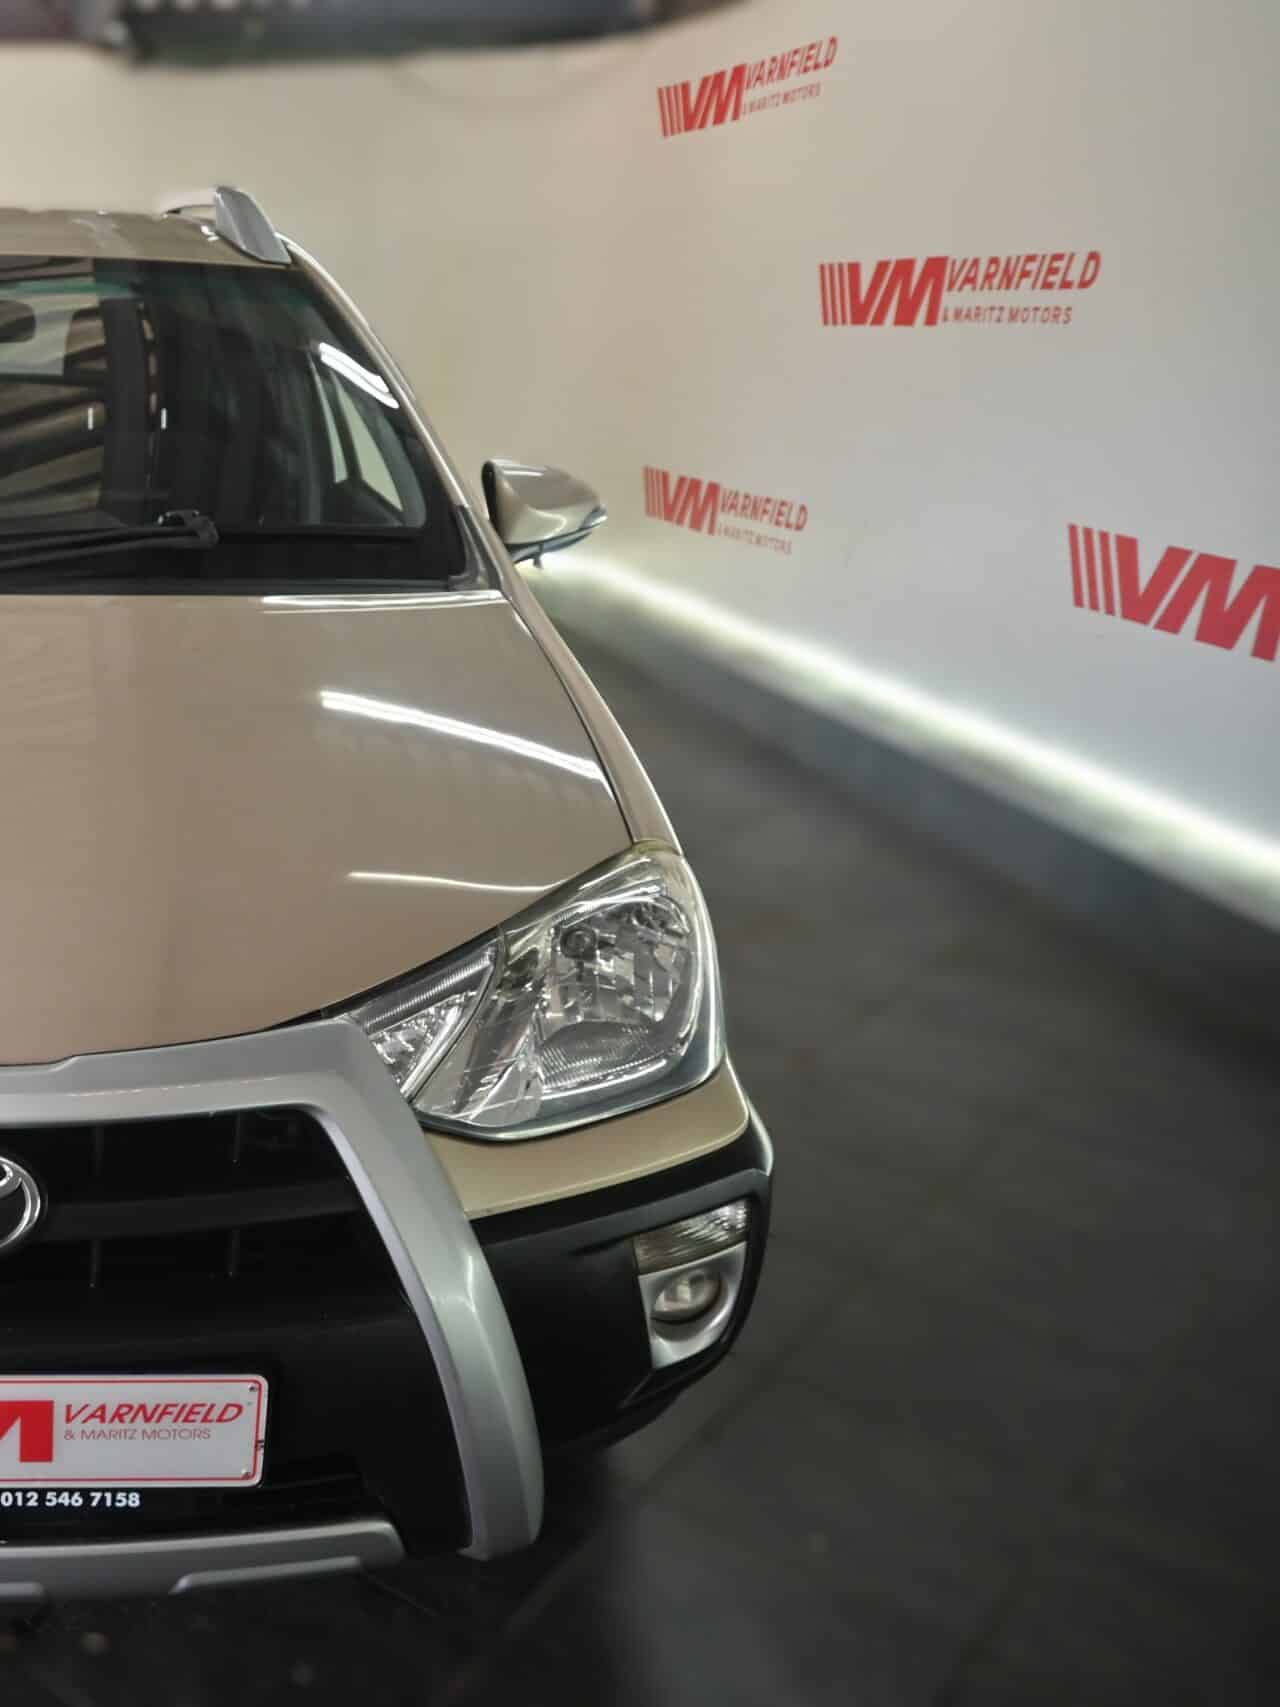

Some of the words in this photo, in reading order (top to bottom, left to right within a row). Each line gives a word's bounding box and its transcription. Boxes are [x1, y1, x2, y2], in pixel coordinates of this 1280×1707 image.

[680, 63, 747, 133] VM
[745, 36, 838, 90] VARNFIELD
[847, 255, 949, 326] VM
[946, 250, 1102, 292] VARNFIELD
[953, 305, 1005, 324] MARITZ
[1008, 305, 1073, 324] MOTORS
[661, 471, 721, 536] VM
[721, 487, 808, 531] VARNFIELD
[64, 1402, 245, 1425] VARNFIELD
[63, 1429, 75, 1441] &
[80, 1428, 138, 1441] MARITZ
[141, 1427, 212, 1440] MOTORS
[0, 1491, 39, 1507] 012
[45, 1491, 84, 1507] 546
[89, 1491, 141, 1508] 7158
